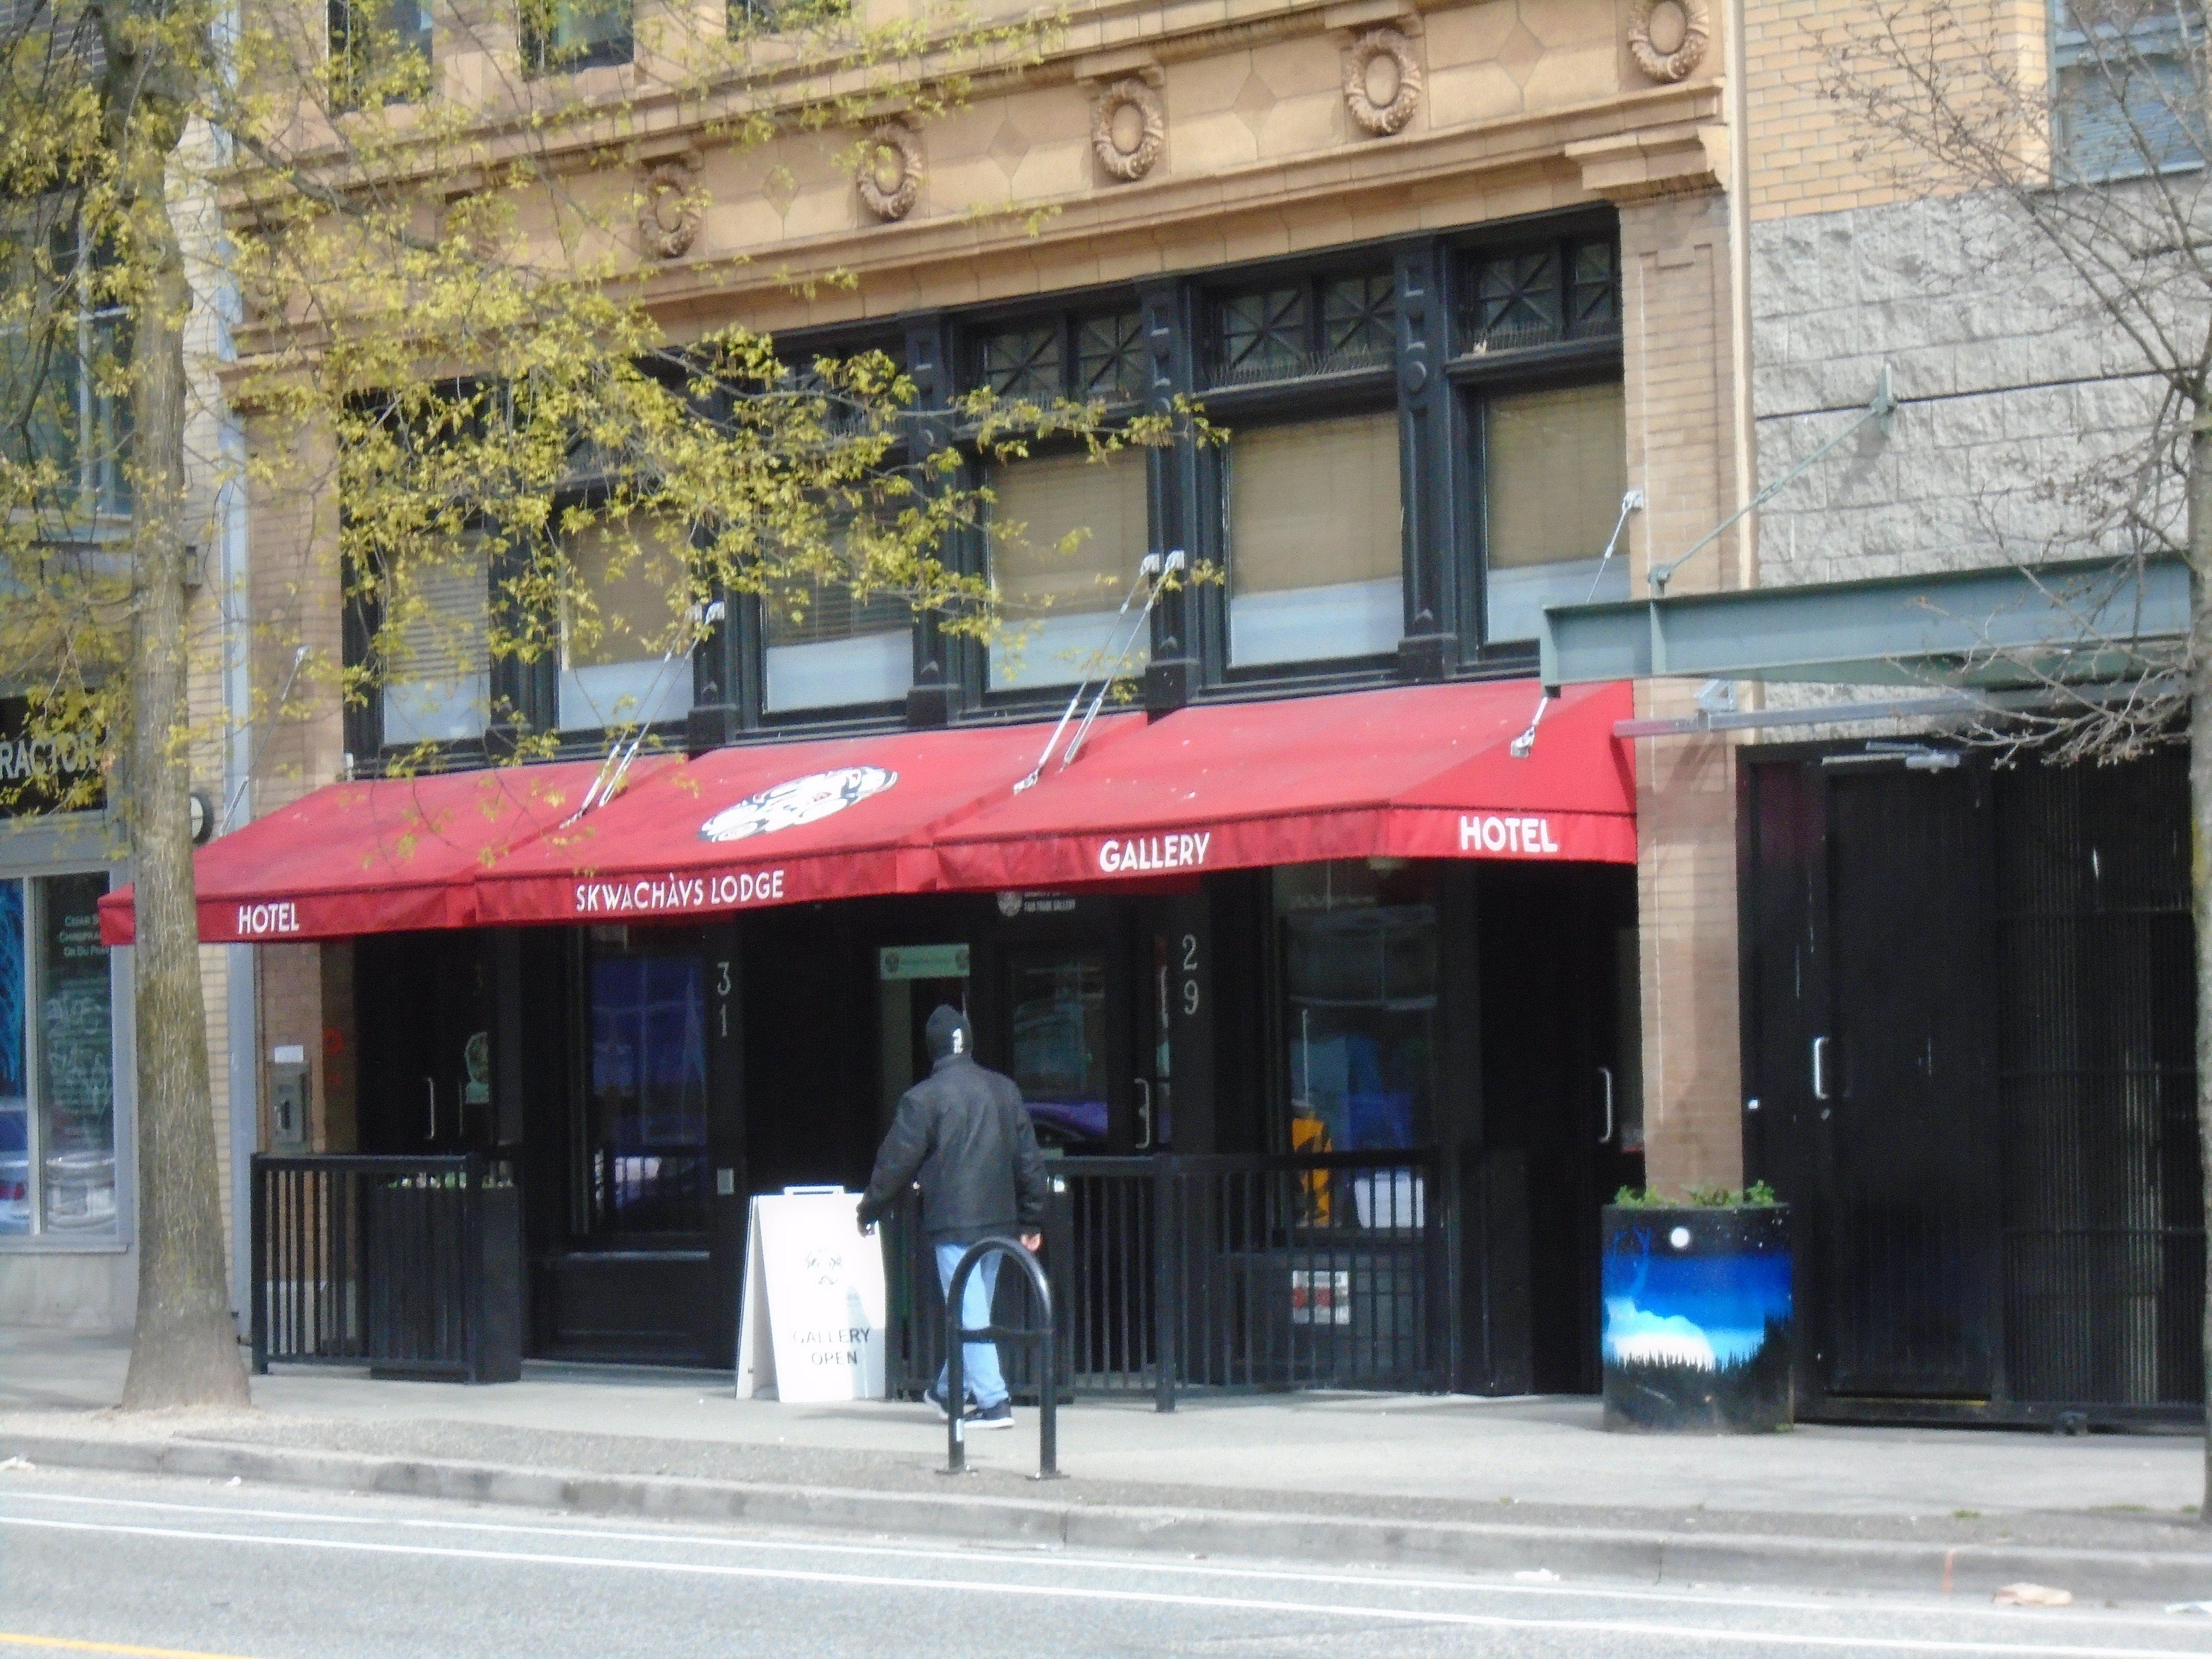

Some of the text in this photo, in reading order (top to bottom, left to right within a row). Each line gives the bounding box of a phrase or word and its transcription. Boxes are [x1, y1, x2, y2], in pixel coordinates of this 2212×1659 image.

[1461, 815, 1559, 853] HOTEL
[1099, 832, 1210, 873] GALLERY
[711, 869, 784, 905] LODGE
[238, 902, 300, 934] HOTEL
[793, 1327, 871, 1344] GALLERY
[811, 1351, 858, 1366] OPEN
